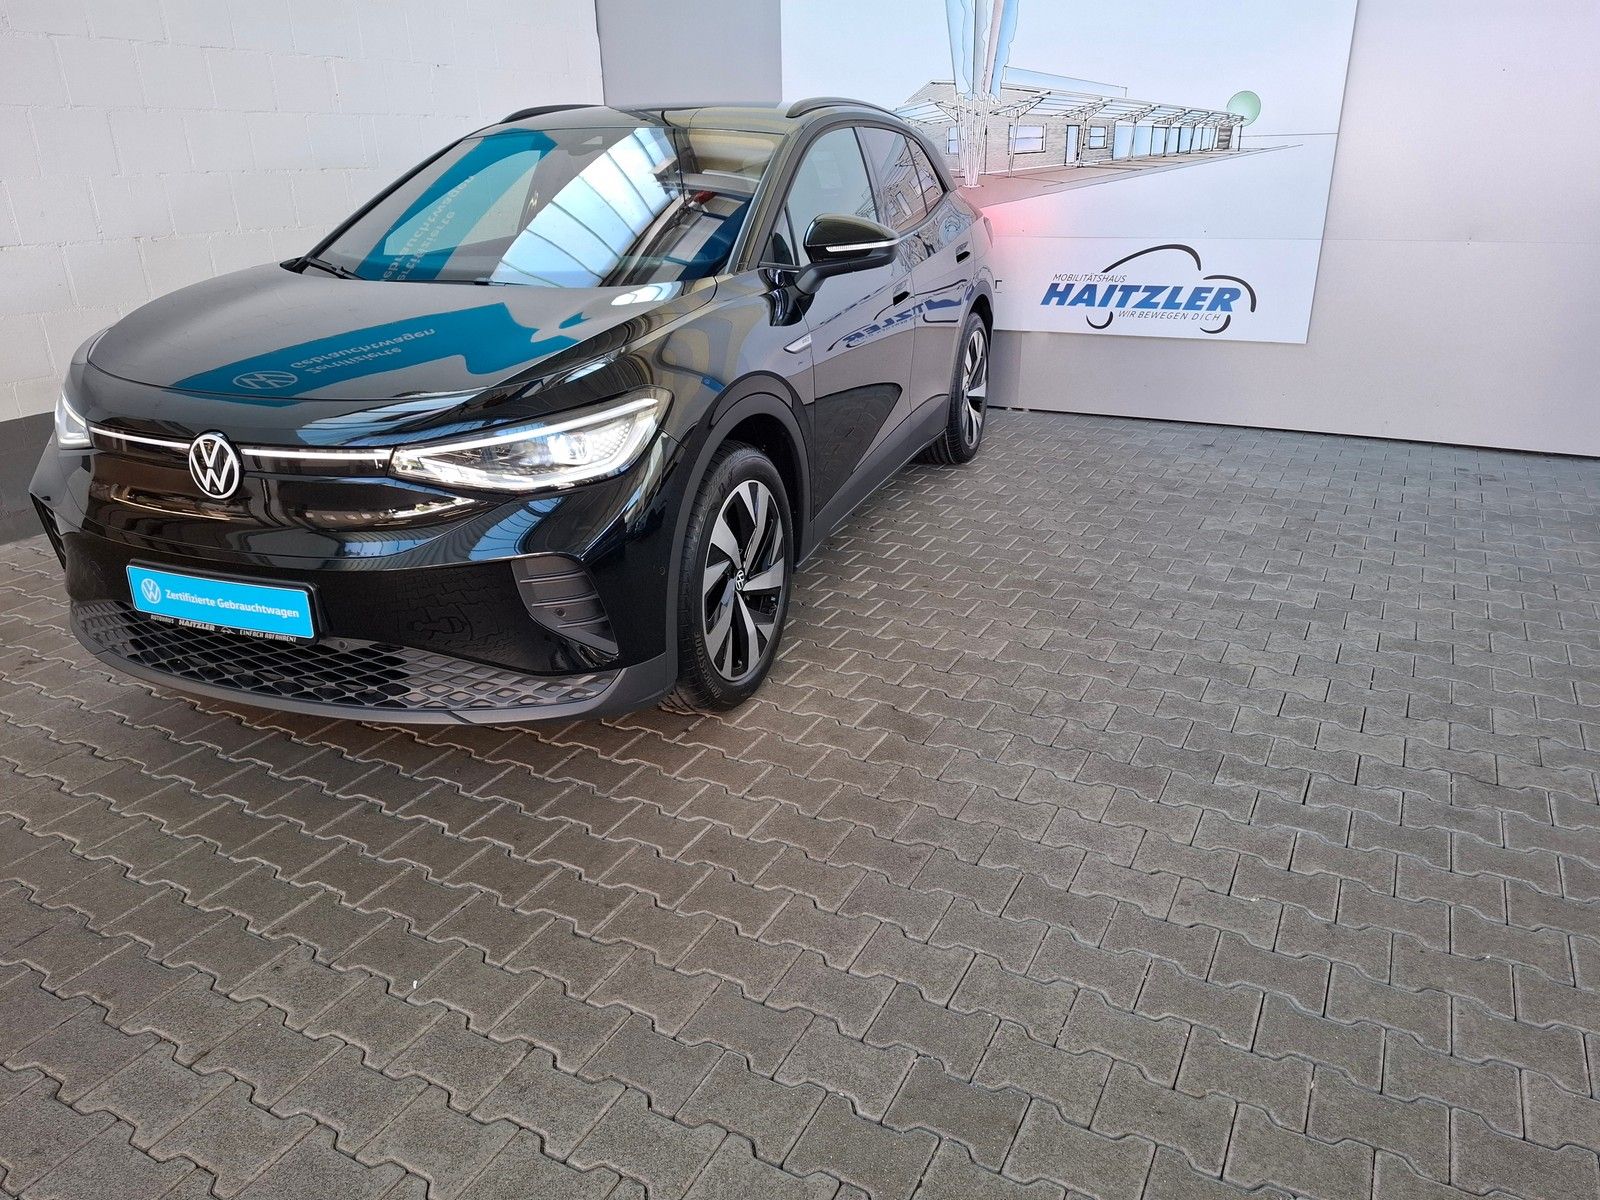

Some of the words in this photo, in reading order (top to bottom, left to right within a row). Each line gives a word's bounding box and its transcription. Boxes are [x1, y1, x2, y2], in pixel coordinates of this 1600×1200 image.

[1052, 272, 1128, 284] MOBILITÄTSHAUS
[1040, 282, 1242, 313] HAITZLER
[1118, 310, 1137, 319] WIR
[1137, 311, 1190, 321] BEWEGEN
[1191, 313, 1222, 322] DICH
[190, 436, 237, 497] VW
[165, 589, 216, 607] Zertifizierte
[217, 598, 300, 619] Gebrauchtwagen
[178, 619, 216, 632] HAITZLER
[239, 629, 263, 639] EINFACH
